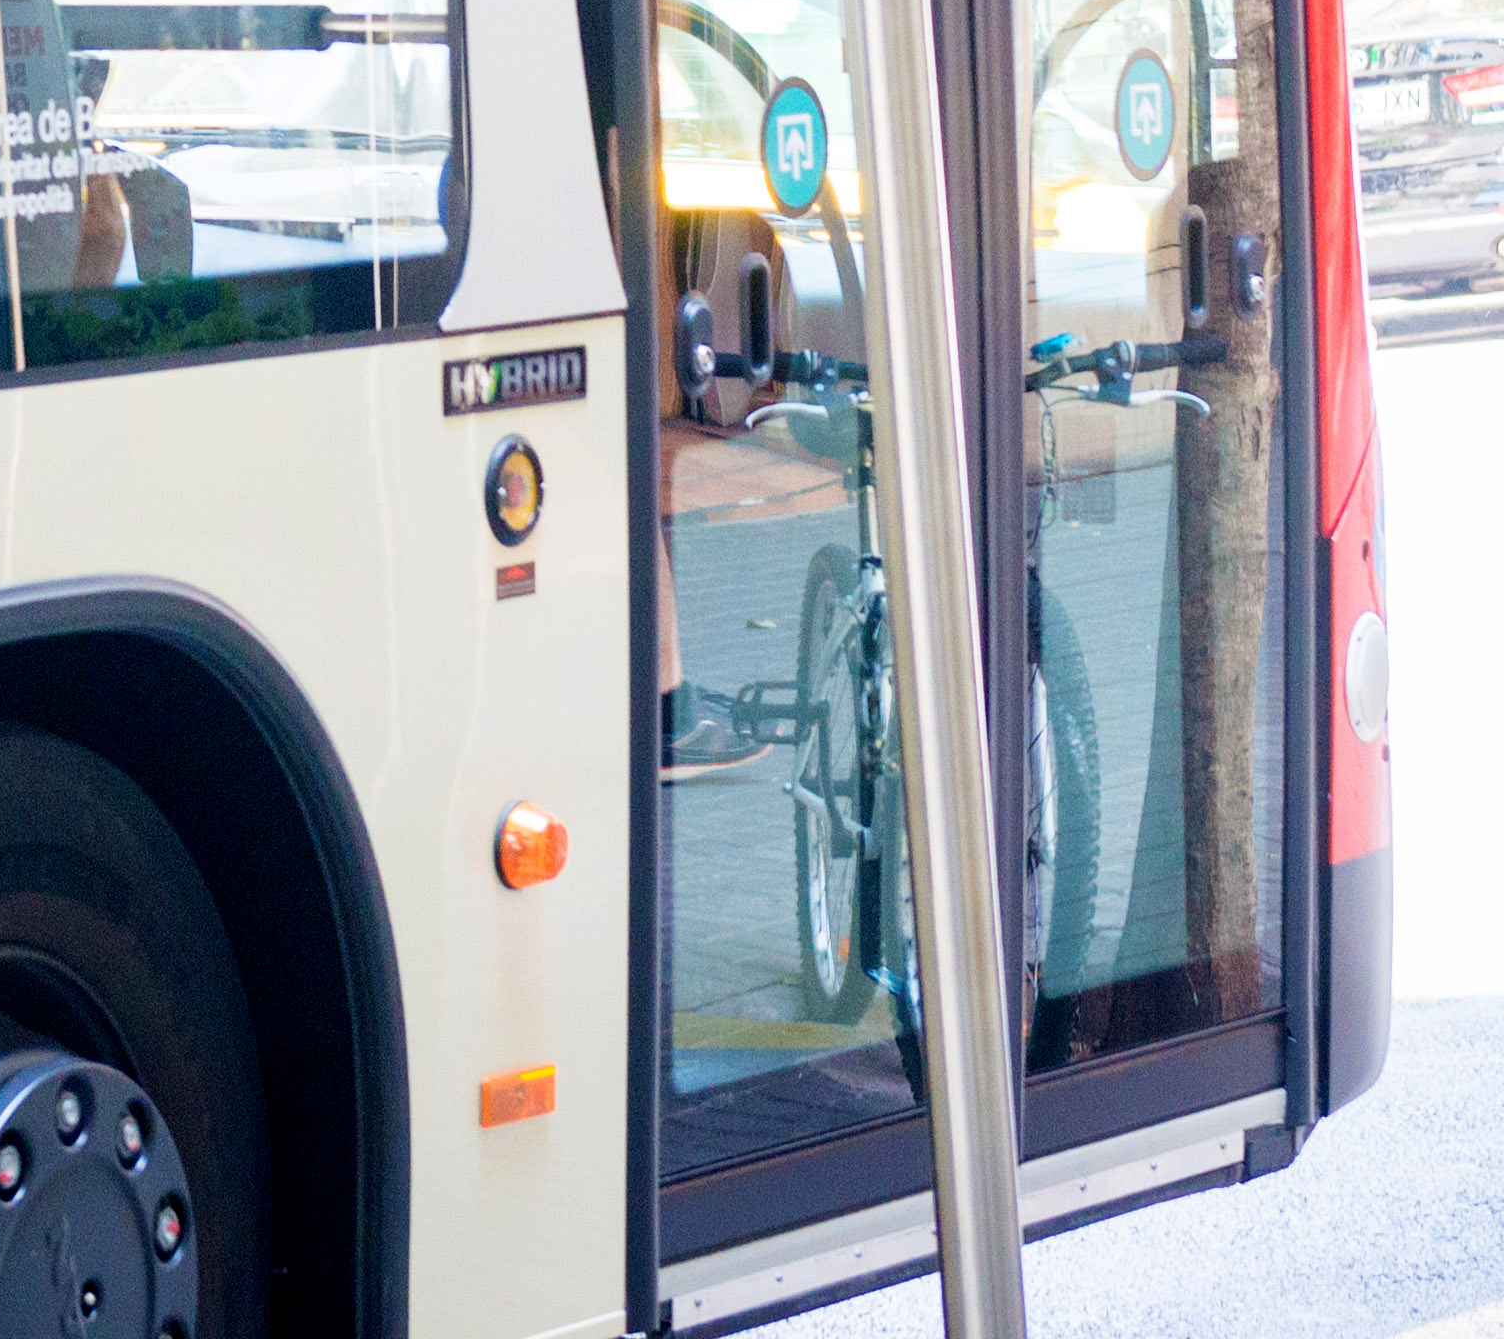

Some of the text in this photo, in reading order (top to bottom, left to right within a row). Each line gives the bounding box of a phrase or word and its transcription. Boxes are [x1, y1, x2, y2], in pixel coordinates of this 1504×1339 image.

[1376, 87, 1423, 114] JXN
[38, 99, 70, 143] de
[52, 151, 78, 178] del
[449, 351, 582, 407] HYBRID
